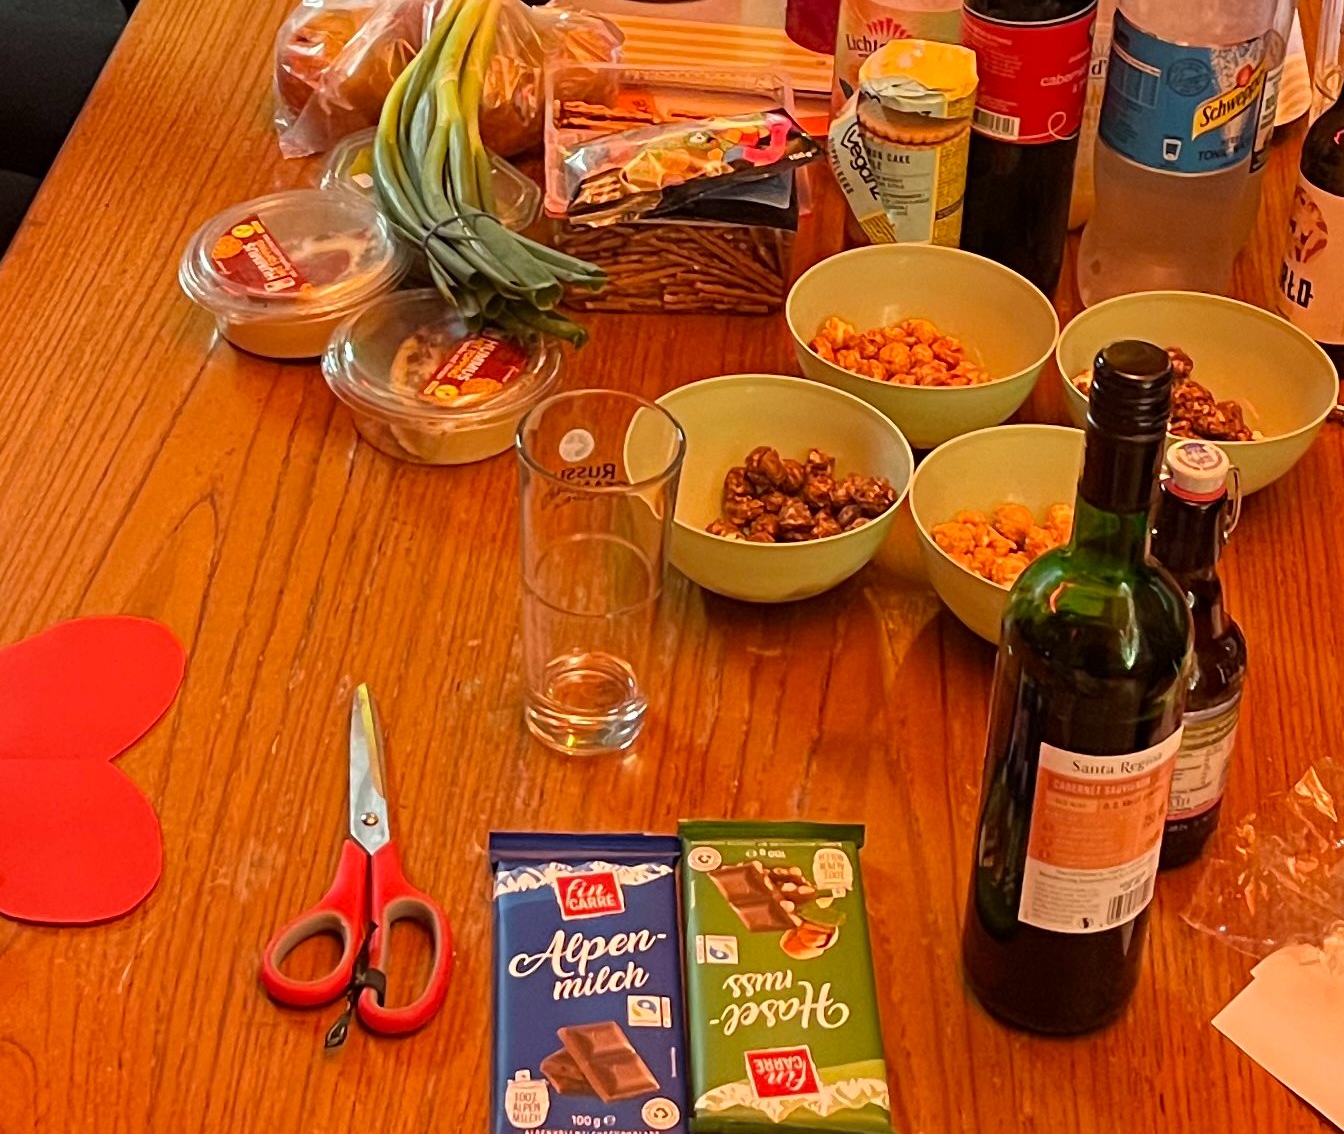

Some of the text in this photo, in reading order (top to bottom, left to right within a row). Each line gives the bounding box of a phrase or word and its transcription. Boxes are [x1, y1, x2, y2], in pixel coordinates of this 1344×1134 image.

[1072, 761, 1114, 774] Santa
[509, 929, 667, 978] Alpen-
[553, 962, 650, 1000] milch
[723, 970, 792, 998] nuss
[709, 981, 850, 1035] Hasel-
[572, 1115, 601, 1129] 100 g
